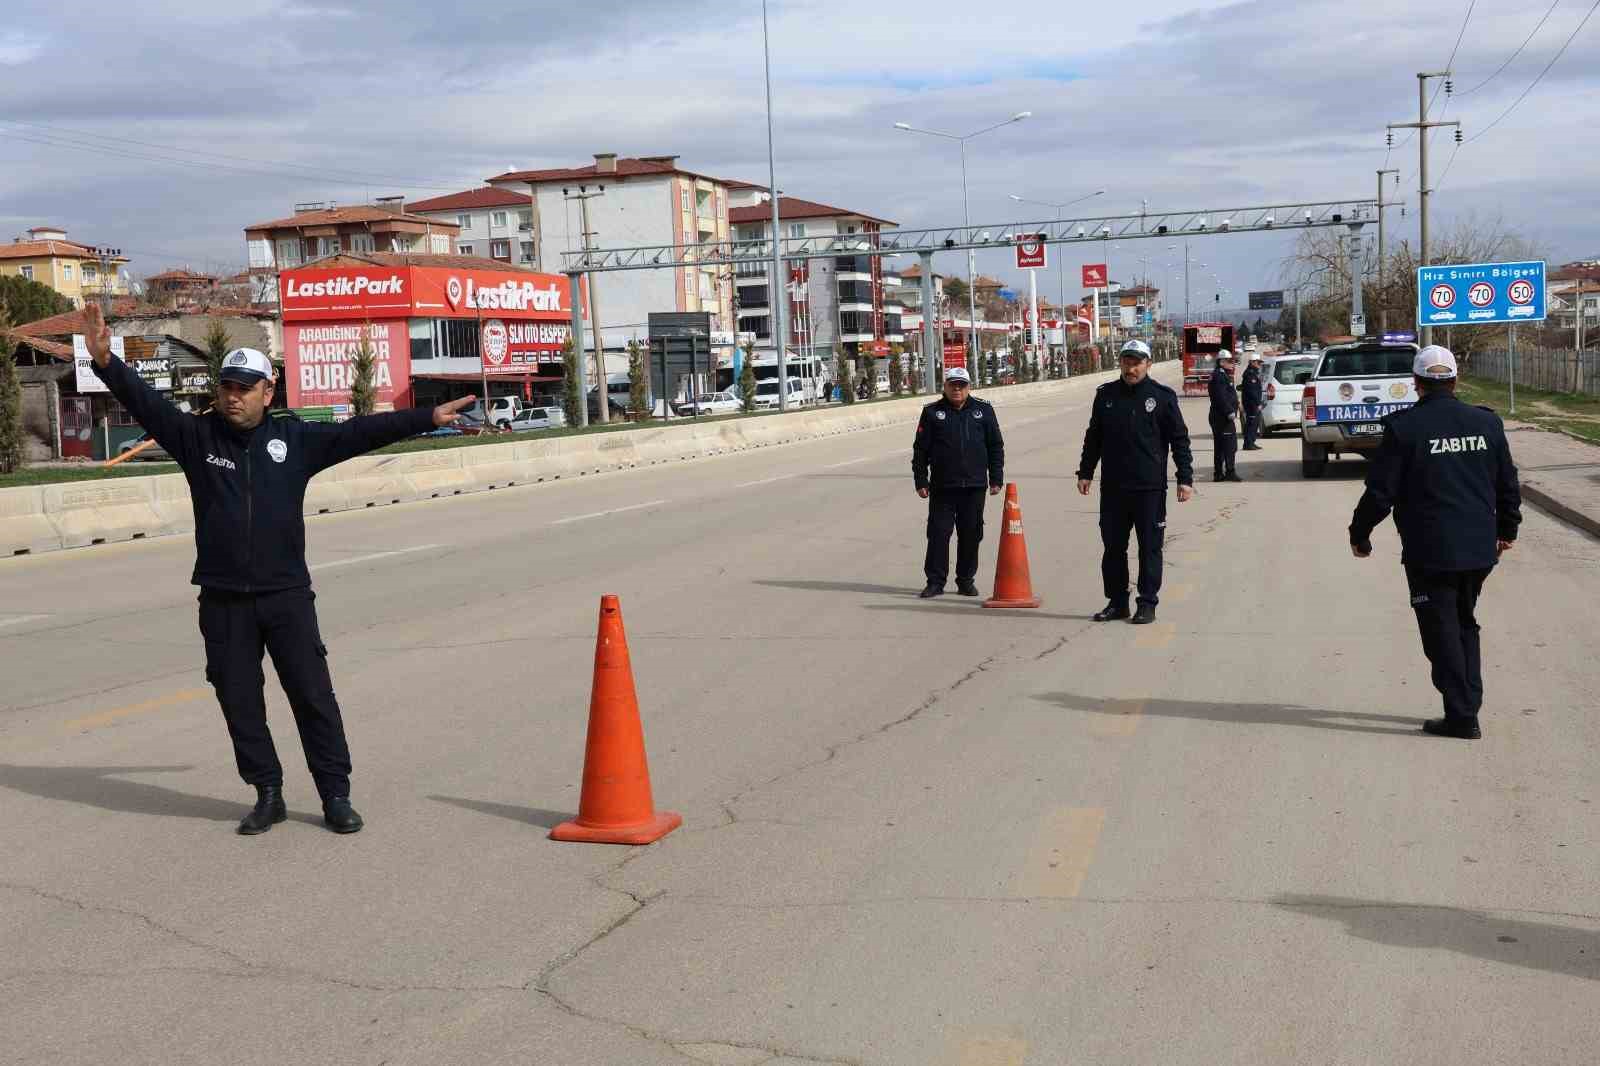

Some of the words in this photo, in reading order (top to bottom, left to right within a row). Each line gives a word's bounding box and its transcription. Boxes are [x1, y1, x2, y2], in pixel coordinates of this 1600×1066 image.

[1492, 266, 1539, 278] Bölgesi
[287, 275, 404, 297] LastikPark
[465, 278, 561, 311] LastikPark
[1475, 288, 1490, 301] 70
[1514, 286, 1530, 299] 50
[1436, 291, 1451, 303] 70
[298, 325, 361, 342] ARADIĞINIZ
[525, 325, 538, 344] OTO
[299, 340, 390, 363] MARKAAR
[301, 361, 393, 391] BURAA
[1374, 403, 1414, 418] ZAB
[1429, 436, 1488, 454] ZABITA
[206, 453, 236, 470] ZABITA
